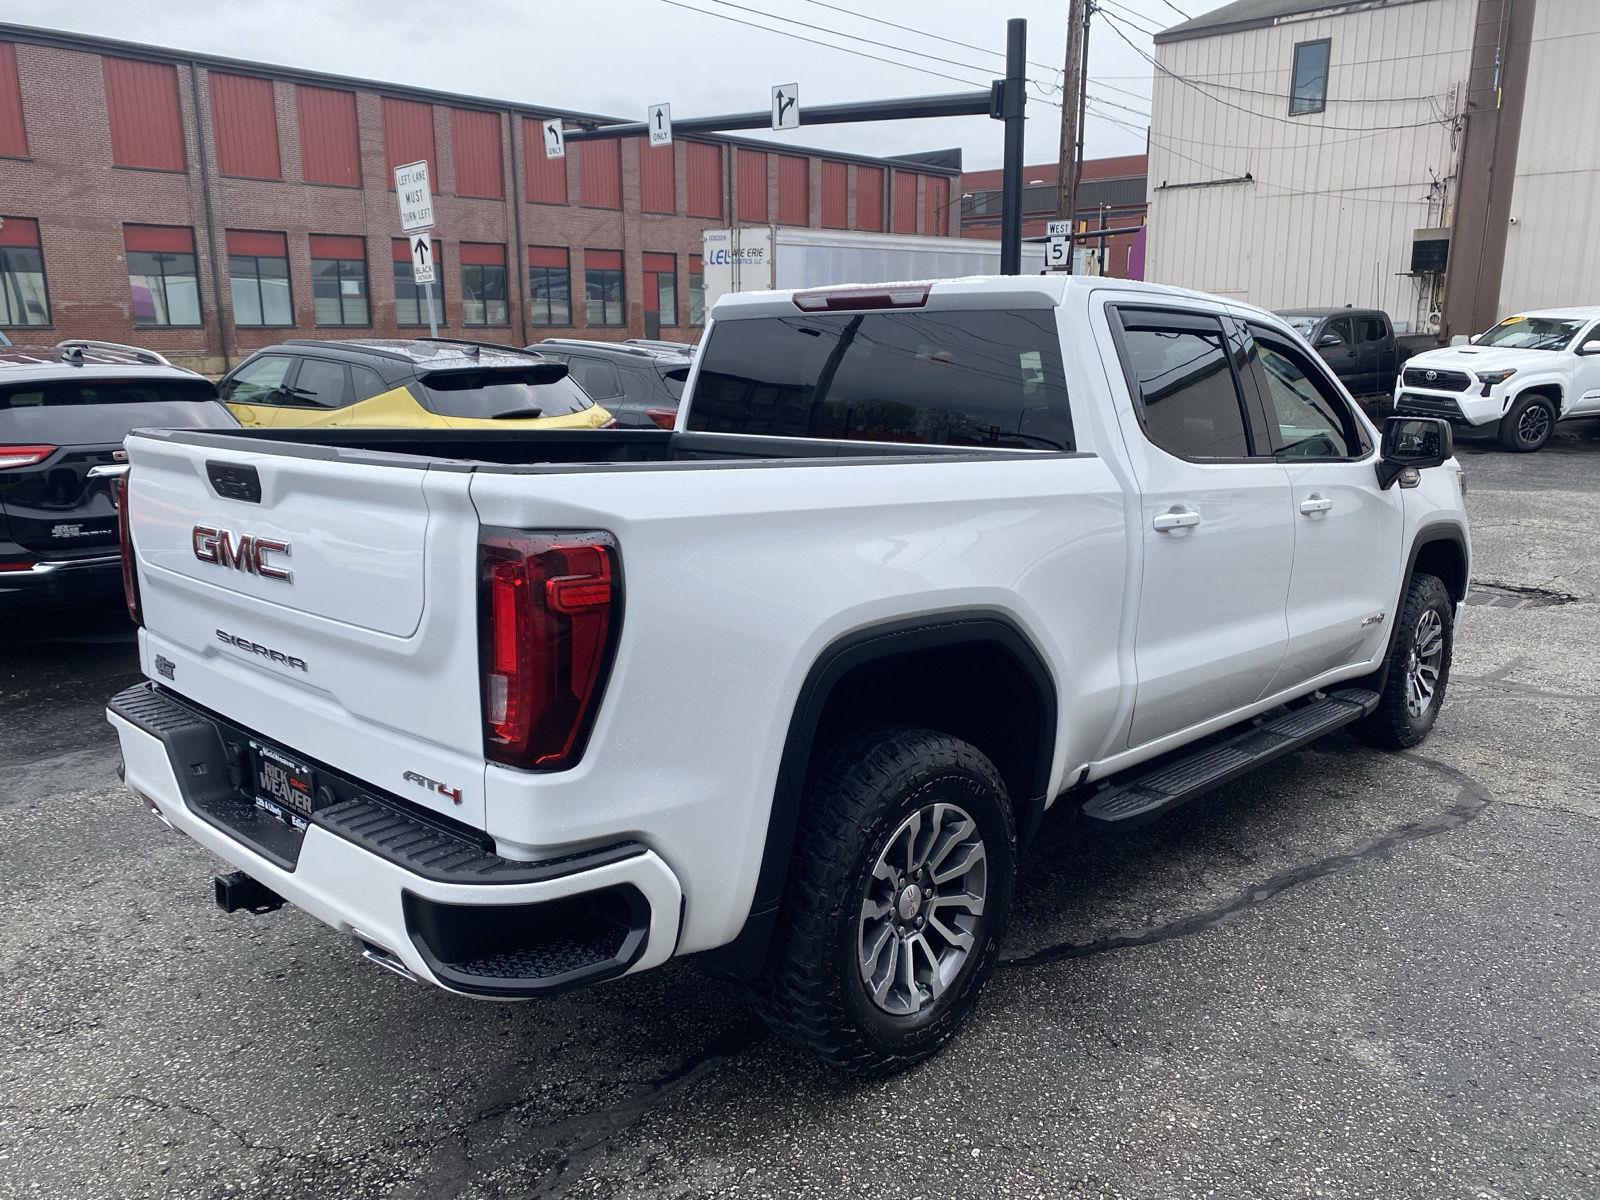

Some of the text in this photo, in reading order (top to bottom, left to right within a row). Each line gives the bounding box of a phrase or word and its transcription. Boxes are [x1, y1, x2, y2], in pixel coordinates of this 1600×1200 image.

[653, 131, 668, 141] ONLY
[548, 145, 562, 155] ONLY
[398, 170, 426, 186] LEFT LANE
[405, 189, 423, 204] MUST
[403, 207, 431, 223] TURN LEFT
[1050, 224, 1069, 234] WEST
[709, 249, 730, 265] LEL
[747, 247, 765, 258] ERIE
[1052, 244, 1063, 260] 5
[415, 265, 432, 275] BLACK
[192, 524, 294, 585] GMC
[216, 628, 308, 672] SIERRA
[264, 761, 287, 783] RICK
[260, 771, 312, 814] WEAVER
[289, 777, 309, 793] GMC
[402, 769, 464, 806] AT4
